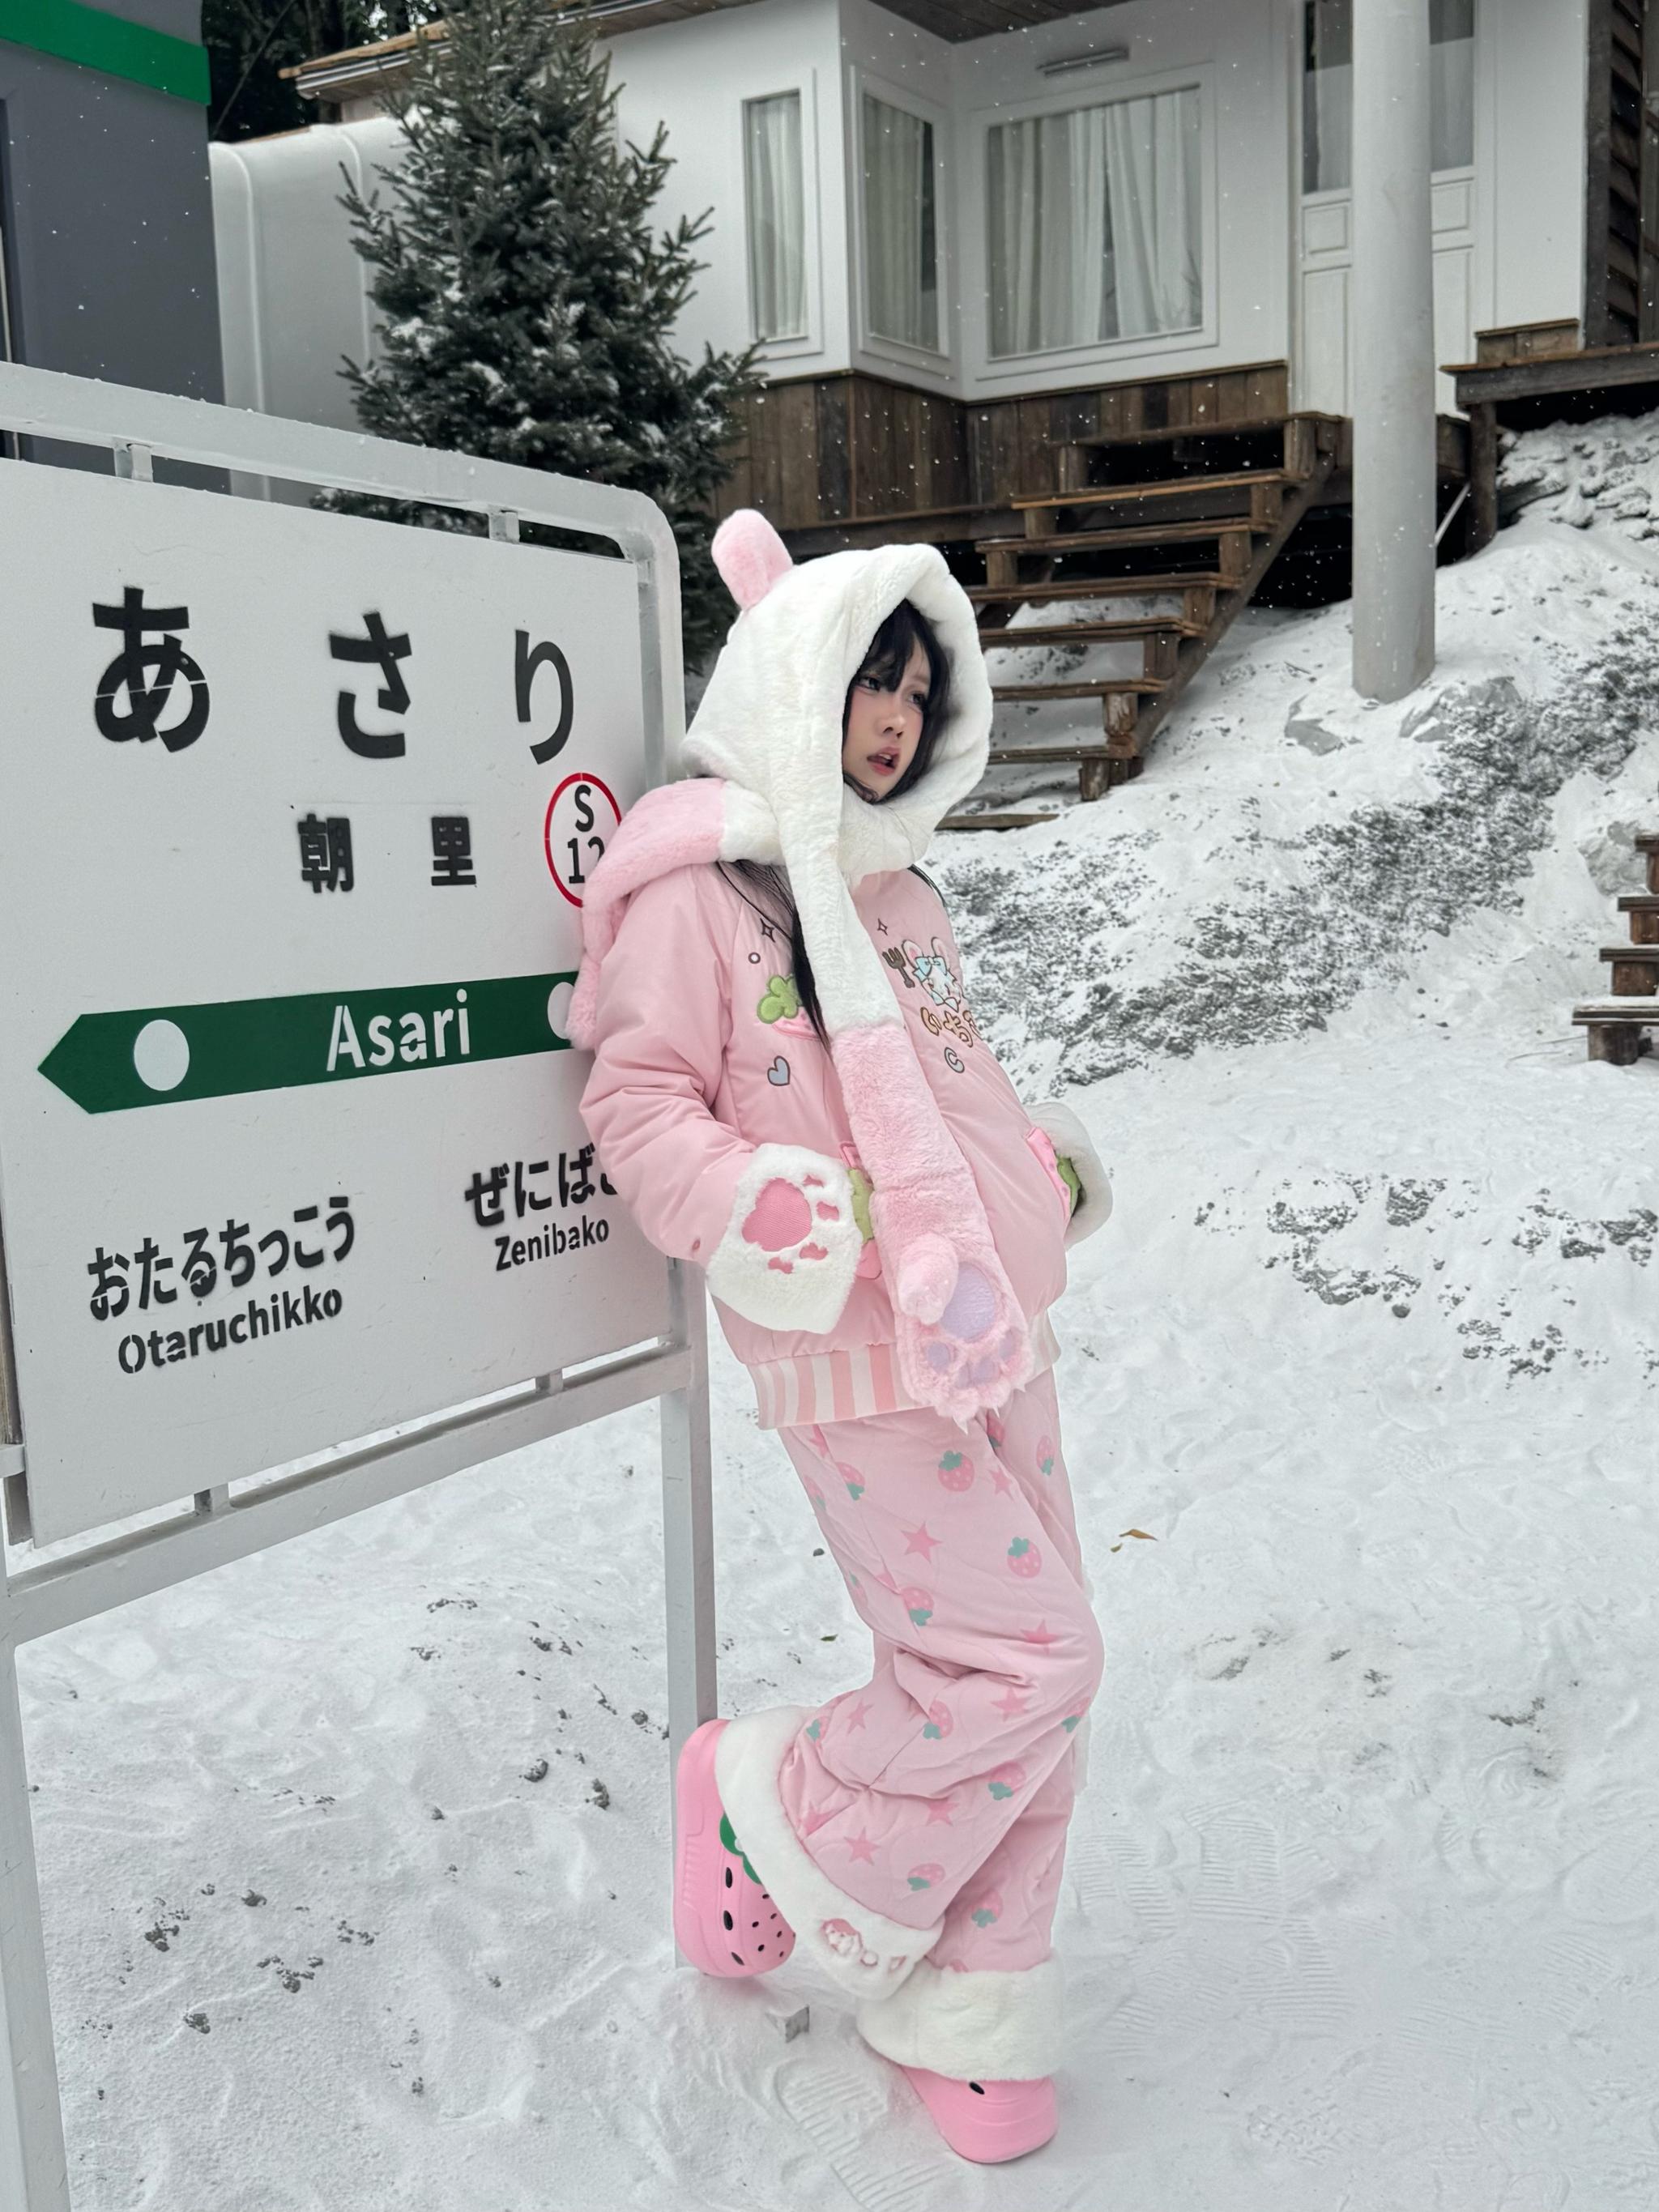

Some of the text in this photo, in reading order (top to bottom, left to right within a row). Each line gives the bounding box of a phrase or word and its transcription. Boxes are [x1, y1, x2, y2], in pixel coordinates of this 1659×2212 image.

[92, 586, 574, 765] あさり
[574, 784, 595, 833] S
[297, 812, 476, 893] 朝里
[326, 988, 471, 1072] Asari
[87, 1196, 355, 1321] おたるちっこう
[495, 1215, 609, 1272] Zenibako
[117, 1285, 343, 1374] Otaruchikko
